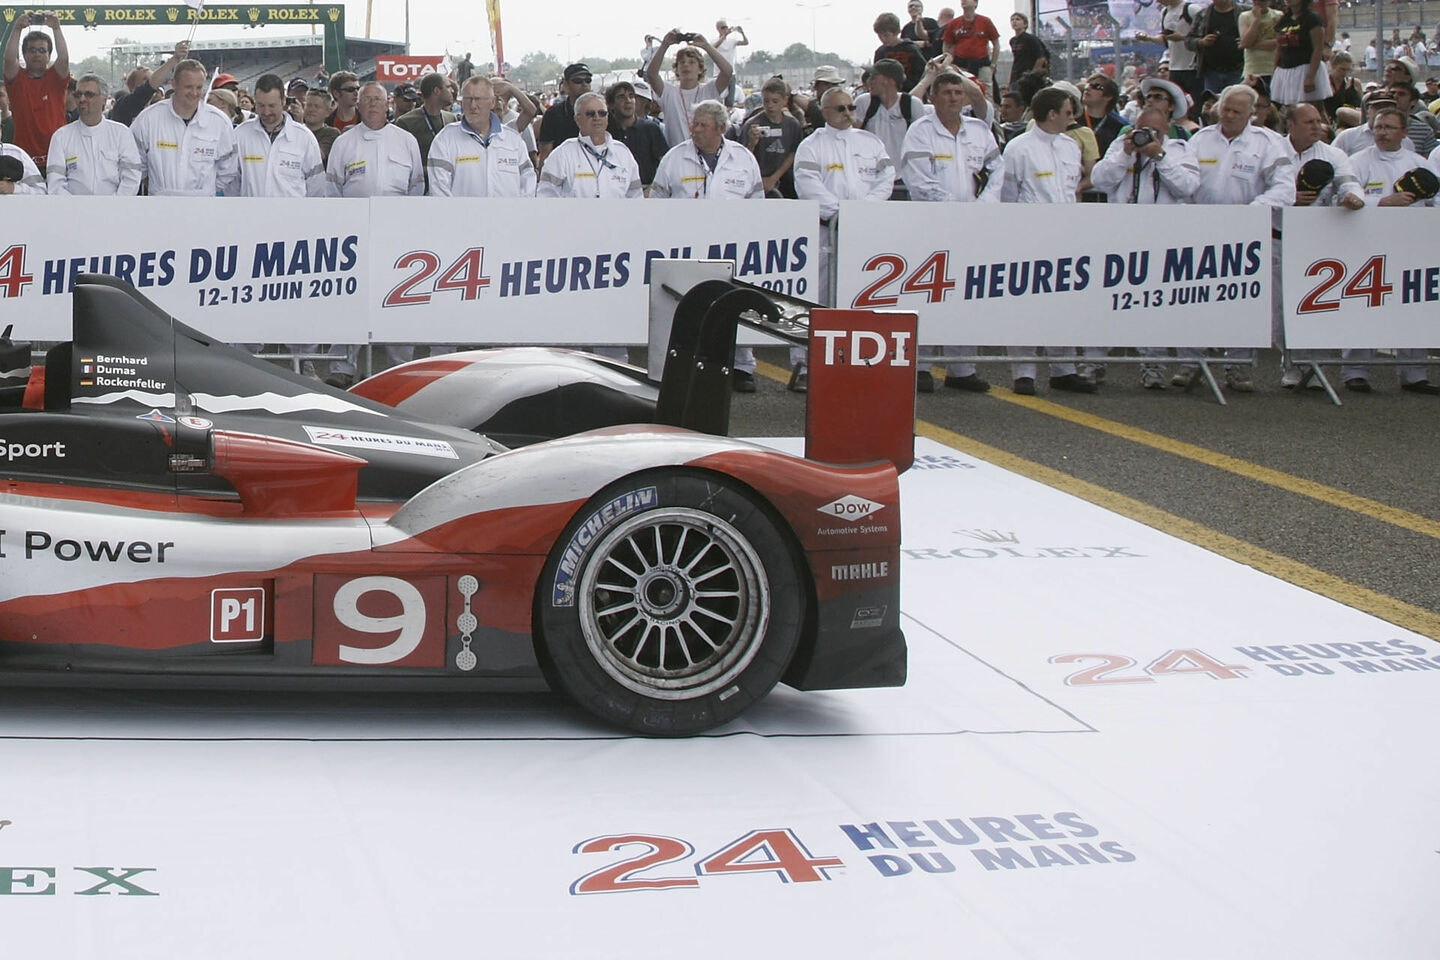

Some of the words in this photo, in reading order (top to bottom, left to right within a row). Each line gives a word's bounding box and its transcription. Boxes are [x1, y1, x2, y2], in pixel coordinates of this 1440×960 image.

[104, 8, 157, 21] ROLEX
[186, 8, 239, 21] ROLEX
[267, 8, 320, 20] ROLEX
[188, 244, 240, 284] DU
[252, 234, 359, 280] MANS
[852, 250, 956, 310] 24
[964, 255, 1091, 300] HEURES
[1103, 250, 1150, 289] DU
[1162, 240, 1261, 284] MANS
[197, 286, 254, 308] 12-13
[259, 281, 305, 303] JUIN
[309, 275, 358, 297] 2010
[382, 246, 491, 308] 24
[499, 250, 631, 297] HEURES
[1296, 255, 1393, 316] 24
[1111, 290, 1163, 312] 12-13
[1168, 286, 1210, 306] JUIN
[1216, 280, 1261, 301] 2010
[96, 355, 148, 366] Bernhard
[814, 330, 911, 367] TDI
[96, 365, 137, 376] Dumas
[96, 377, 167, 390] Rockenfeller
[350, 435, 393, 445] HEURES
[560, 488, 653, 577] MICHELIN
[817, 527, 859, 536] Automotive
[860, 524, 888, 535] Systems
[26, 532, 175, 565] Power
[900, 546, 1150, 561] ROLEX
[831, 561, 889, 580] MAHLE
[221, 596, 255, 634] P1
[332, 575, 427, 665] 9
[1047, 648, 1254, 688] 24
[1234, 638, 1428, 665] HEURES
[1262, 659, 1336, 677] DU
[568, 827, 848, 896] 24
[839, 812, 1100, 851] HEURES
[866, 851, 957, 878] DU
[969, 841, 1138, 872] MANS
